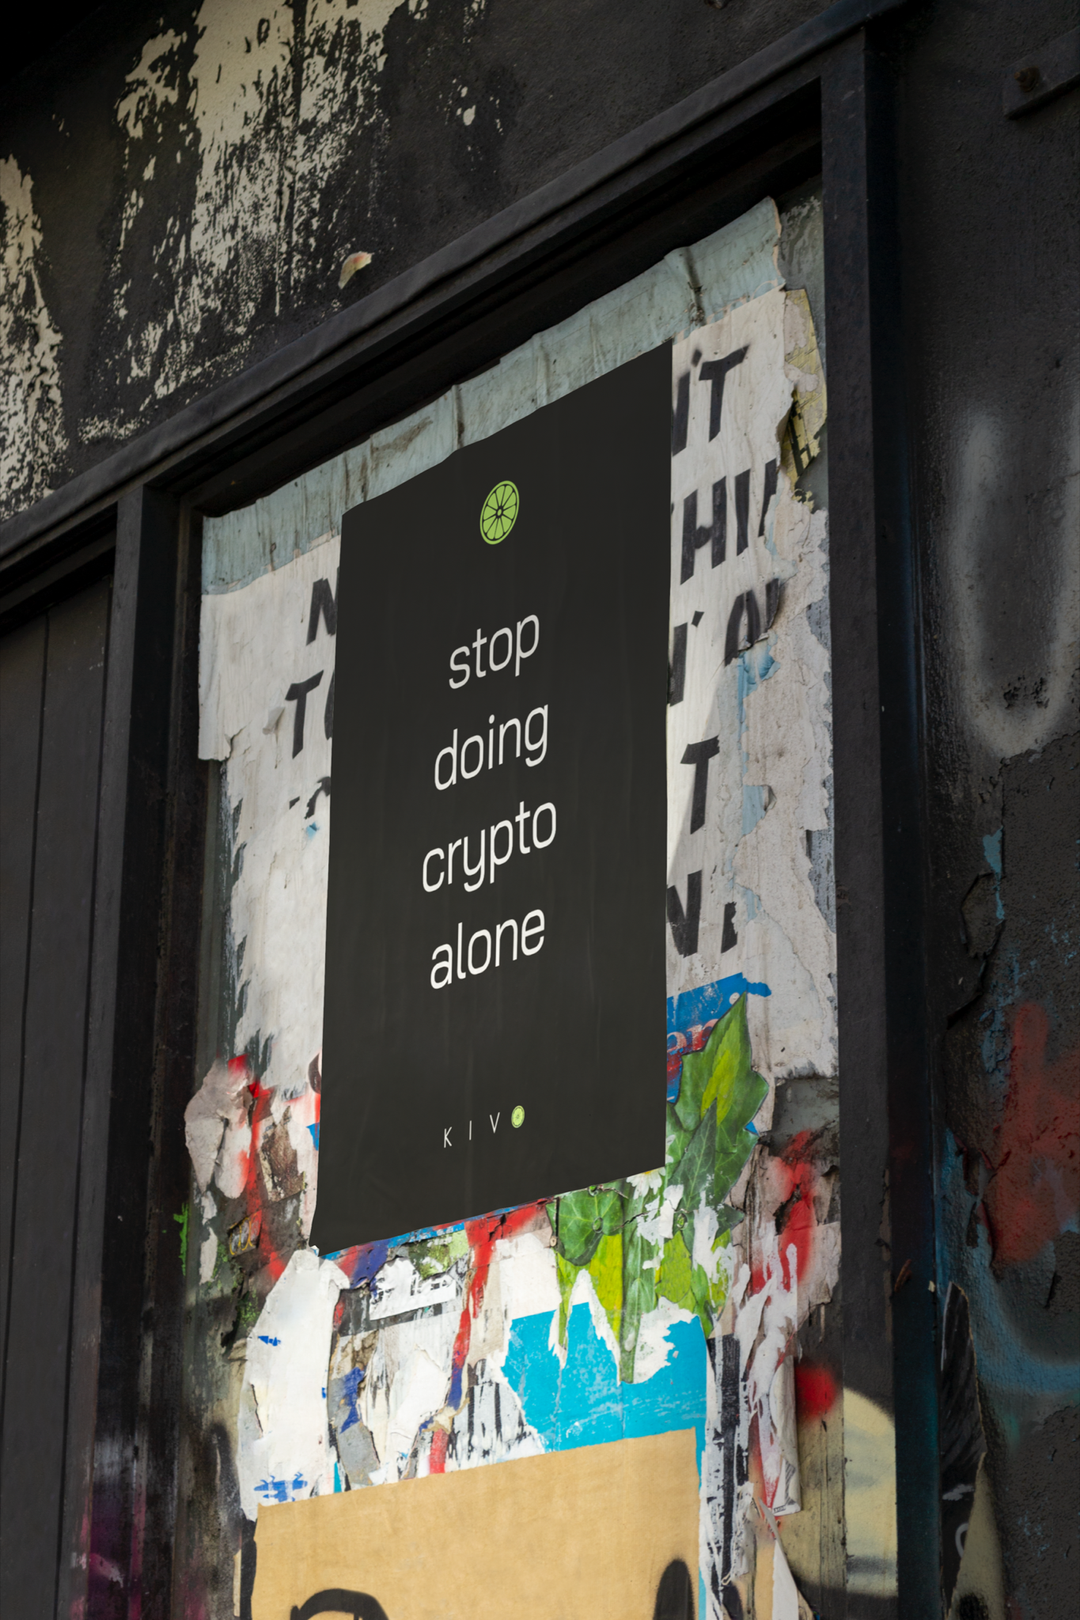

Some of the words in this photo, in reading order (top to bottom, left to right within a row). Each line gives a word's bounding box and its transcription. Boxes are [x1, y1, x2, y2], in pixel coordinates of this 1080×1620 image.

[448, 614, 541, 691] stop
[433, 703, 550, 792] doing
[421, 801, 559, 894] crypto
[429, 908, 547, 991] alone
